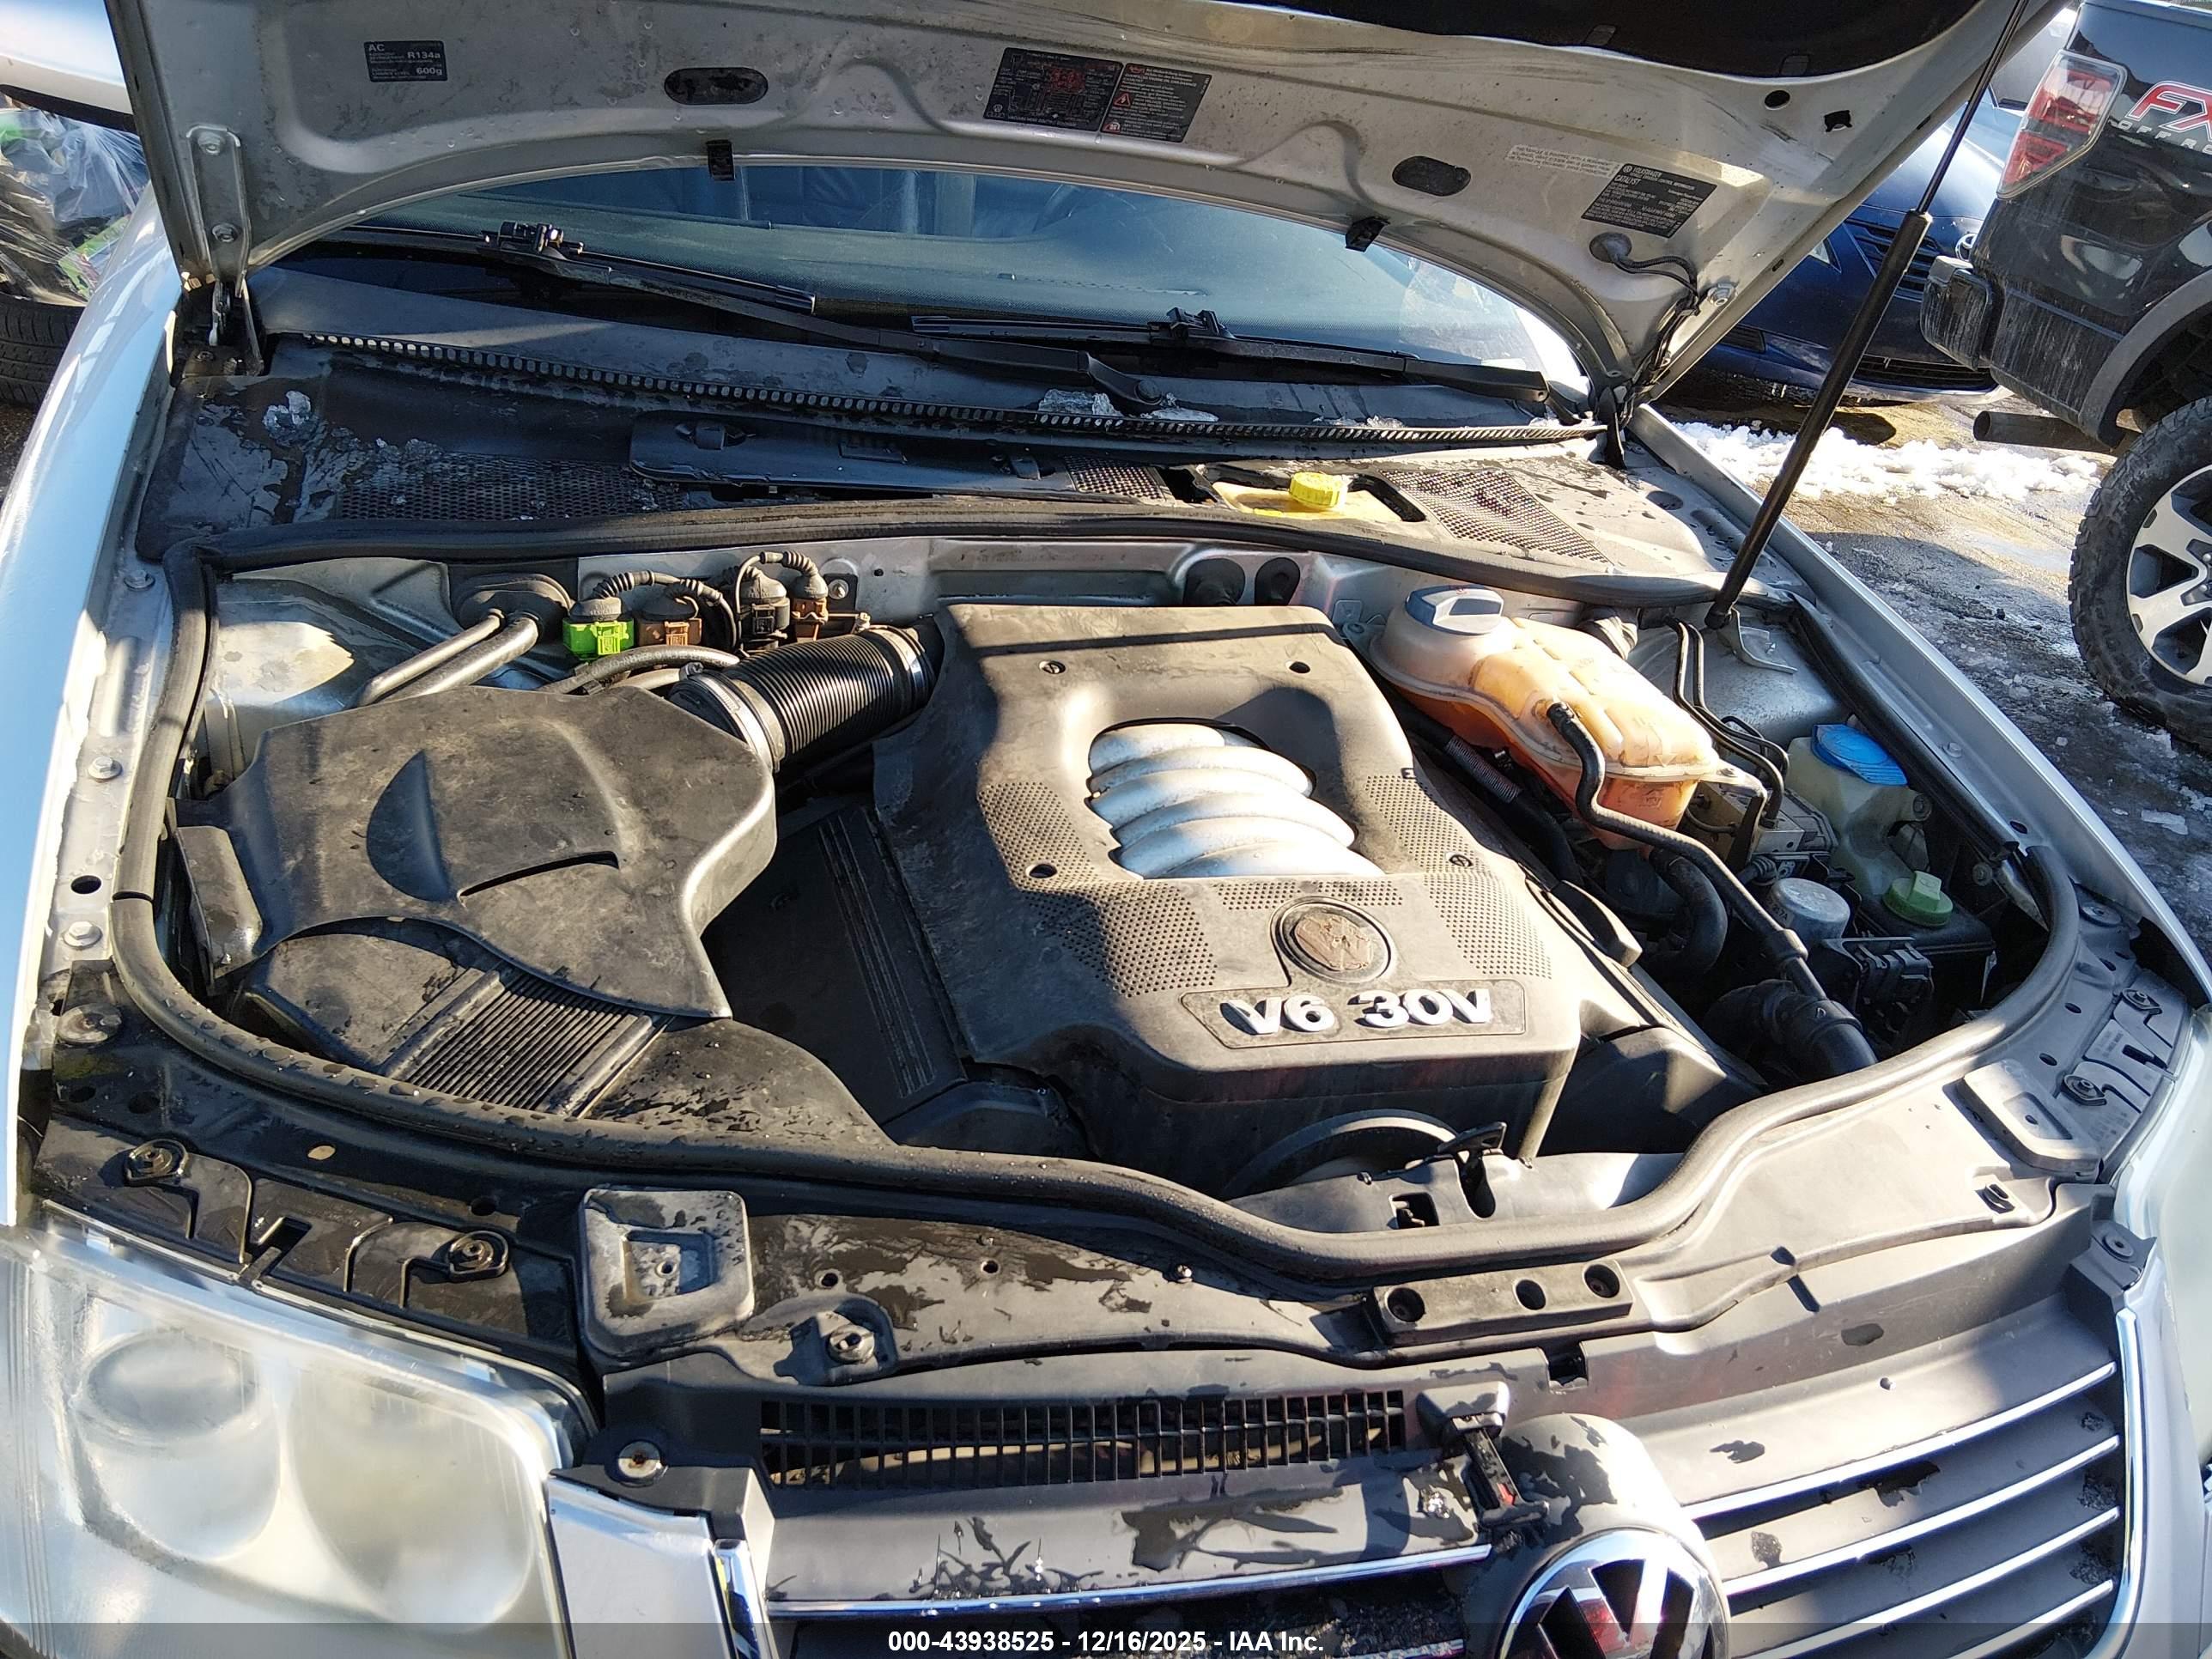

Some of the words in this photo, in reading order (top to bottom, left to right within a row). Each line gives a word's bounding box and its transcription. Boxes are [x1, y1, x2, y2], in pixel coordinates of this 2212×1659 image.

[416, 67, 443, 76] 600g
[2117, 119, 2172, 139] OFF
[1613, 174, 1642, 185] CATALYST
[1221, 994, 1335, 1035] V6
[1350, 988, 1492, 1029] 30V
